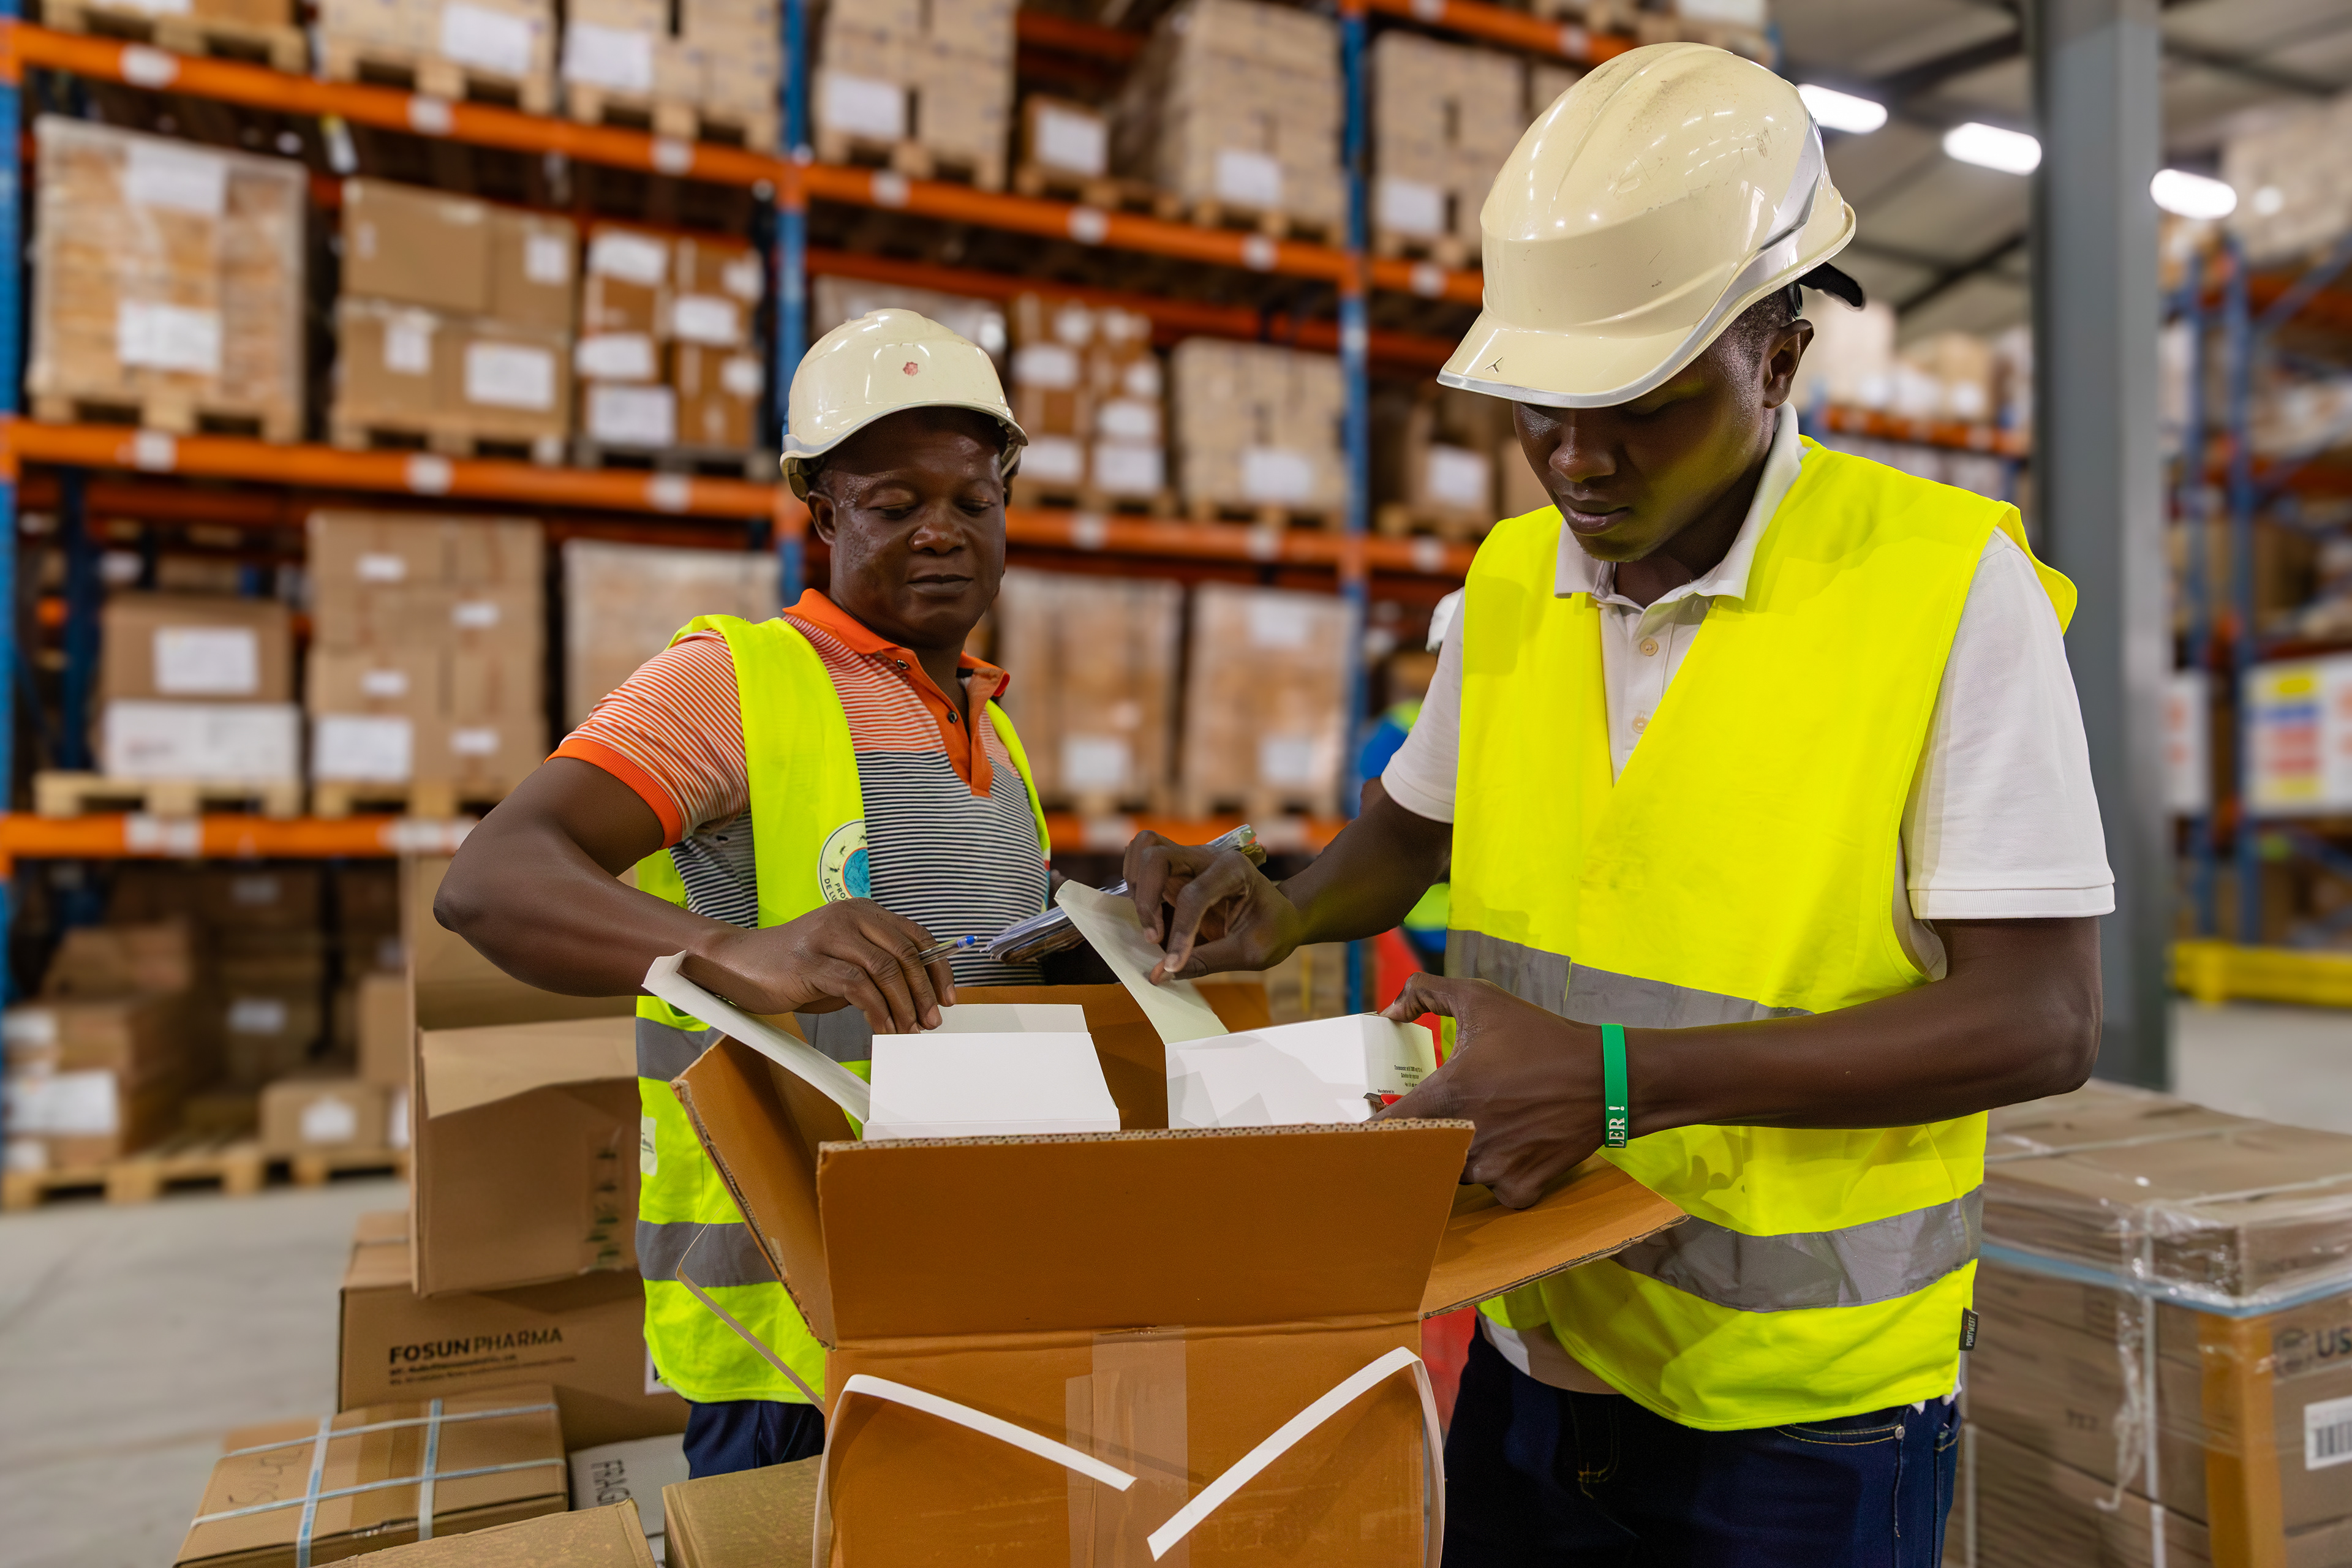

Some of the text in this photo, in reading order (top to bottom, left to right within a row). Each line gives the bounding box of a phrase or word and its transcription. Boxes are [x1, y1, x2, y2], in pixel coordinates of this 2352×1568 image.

[824, 878, 832, 890] DE
[835, 883, 850, 900] PRO
[1965, 1315, 1976, 1346] PORTWEST
[388, 1327, 564, 1365] FOSUN PHARMA
